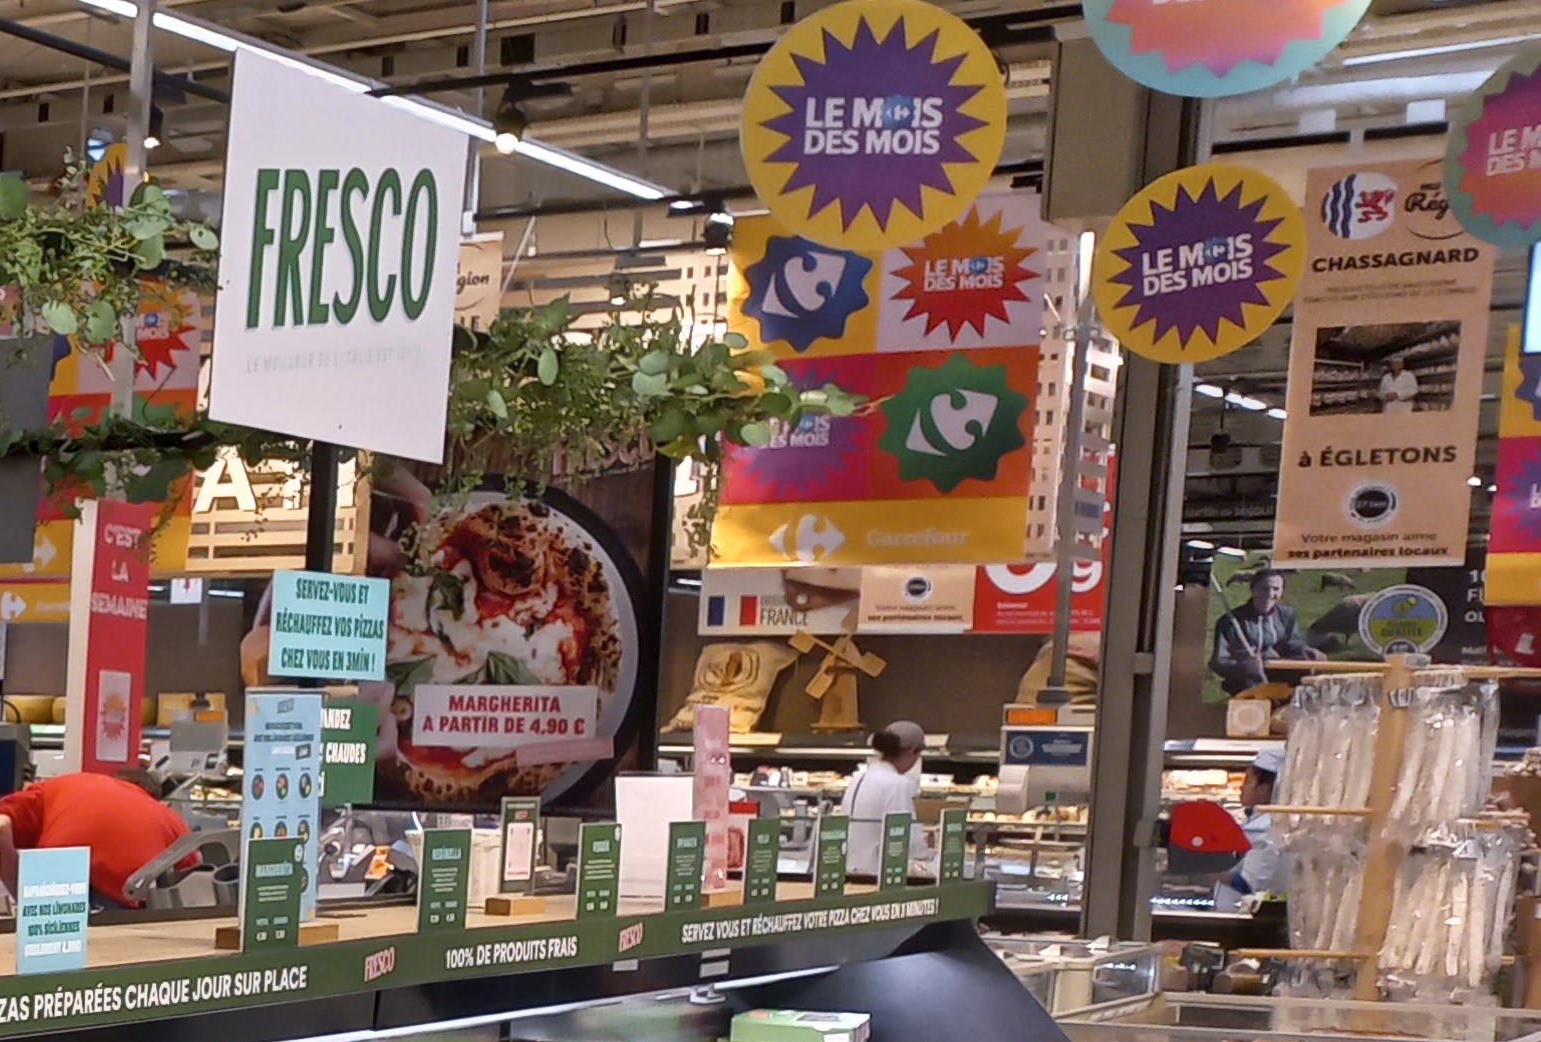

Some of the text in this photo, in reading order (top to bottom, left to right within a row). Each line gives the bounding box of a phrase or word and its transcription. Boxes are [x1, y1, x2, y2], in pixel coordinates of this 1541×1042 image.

[806, 96, 943, 128] LE MIS
[804, 130, 940, 155] DES MOIS
[1488, 129, 1516, 156] LE
[1405, 193, 1449, 220] Rég
[246, 167, 438, 329] FRESCO
[1142, 234, 1253, 275] LE MIS
[1312, 247, 1479, 273] CHASSAGNARD
[925, 256, 1004, 277] LE MIS
[1143, 258, 1253, 296] DES MOIS
[924, 273, 1003, 292] DES MOIS
[790, 431, 830, 447] MOIS
[1298, 445, 1457, 468] à ÉGLETONS
[866, 527, 969, 548] Carrefour
[1301, 532, 1338, 545] Votre
[1342, 532, 1399, 546] magasin
[1312, 547, 1395, 561] partenaires
[111, 562, 129, 582] LA
[296, 577, 369, 604] SERVEZ-VOUS ET
[91, 593, 148, 619] SEMAINE
[759, 609, 809, 627] FRANCE
[275, 607, 384, 641] RÉCHAUFFEZ VOS PIZZAS
[281, 647, 303, 669] CHEZ
[306, 649, 330, 672] VOUS
[332, 651, 344, 672] EN
[449, 694, 561, 714] MARGHERITA
[422, 713, 435, 733] À
[439, 714, 500, 734] PARTIR
[505, 716, 526, 734] DE
[529, 717, 568, 735] 4,90
[325, 742, 367, 765] CHAUDES
[682, 921, 714, 944] SERVEZ
[716, 920, 739, 940] VOUS
[740, 919, 751, 937] ET
[752, 912, 803, 937] RÉCHAUFFEZ
[803, 911, 828, 931] VOTRE
[828, 908, 850, 928] PIZZA
[850, 906, 870, 926] CHEZ
[871, 903, 890, 922] VOUS
[618, 922, 645, 953] FRESCO
[363, 946, 396, 983] FRESCO
[445, 936, 578, 970] 100% DE PRODUITS FRAIS
[34, 981, 122, 1019] PRÉPARÉES
[124, 975, 191, 1011] CHAQUE
[192, 973, 232, 1001] JOUR
[234, 970, 262, 996] SUR
[264, 965, 308, 992] PLACE
